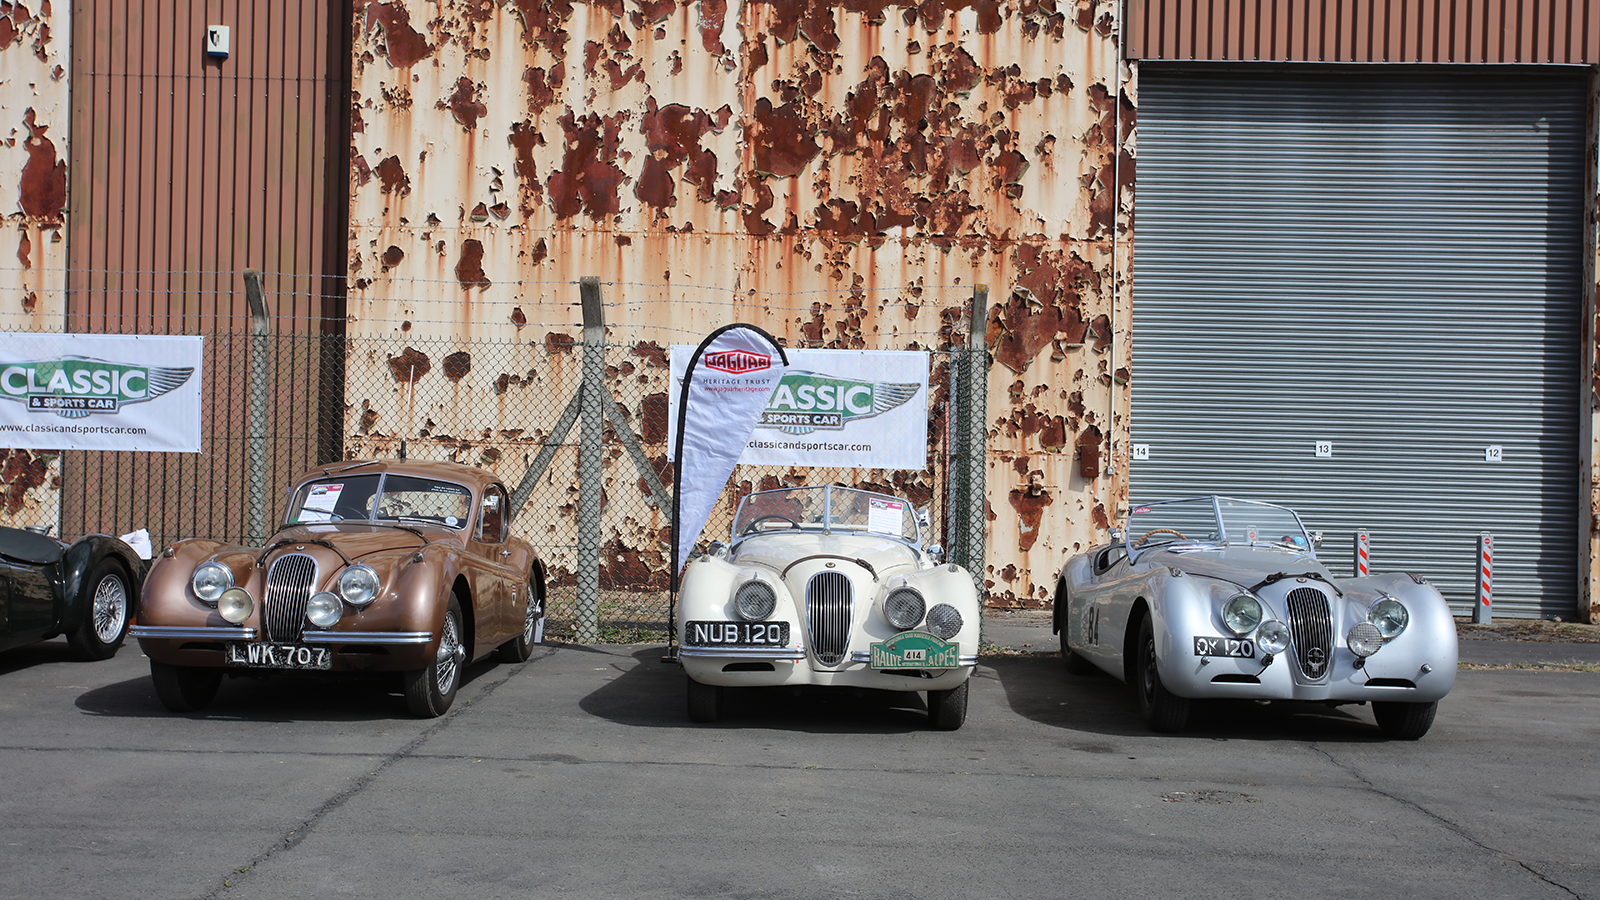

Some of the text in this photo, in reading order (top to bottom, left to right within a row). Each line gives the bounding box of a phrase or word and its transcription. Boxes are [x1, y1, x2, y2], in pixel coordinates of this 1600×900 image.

[708, 353, 767, 371] JAGUAR
[0, 366, 146, 398] CLASSIC
[32, 397, 114, 409] & SPORTS CAR
[768, 384, 872, 414] ASSIC
[767, 414, 810, 424] SPORTS
[813, 415, 838, 425] CAR
[0, 423, 147, 435] www.classicandsportscar.com
[1136, 447, 1146, 455] 14
[1319, 444, 1329, 453] 13
[1489, 449, 1499, 457] 12
[694, 624, 780, 643] NUB 120
[1088, 606, 1099, 646] 84
[232, 644, 326, 665] LWK 707
[873, 646, 901, 666] RALLYE
[906, 651, 921, 659] 414
[928, 647, 956, 666] ALPES
[1224, 639, 1253, 657] 120
